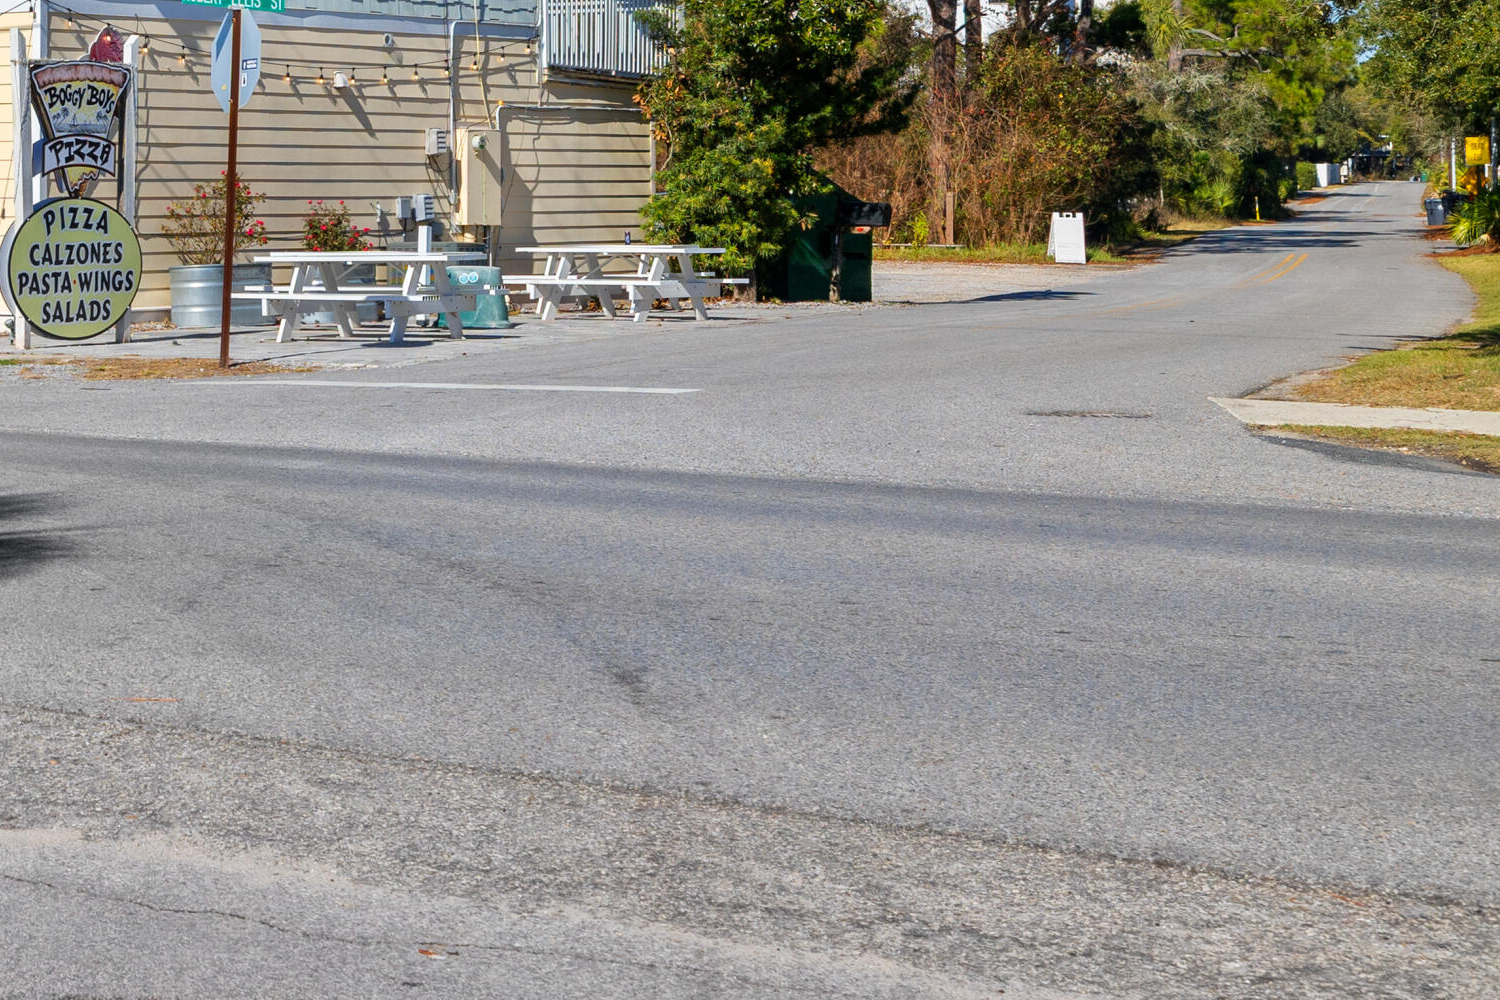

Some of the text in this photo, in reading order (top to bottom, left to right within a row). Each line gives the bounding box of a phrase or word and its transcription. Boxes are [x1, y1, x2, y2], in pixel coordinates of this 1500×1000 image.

[43, 84, 115, 114] BOGGY BOYS
[47, 137, 112, 167] PIZZA
[43, 206, 109, 237] PIZZA
[29, 241, 123, 267] CALZONES
[17, 269, 134, 297] PASTA WINGS
[41, 298, 111, 324] SALADS
